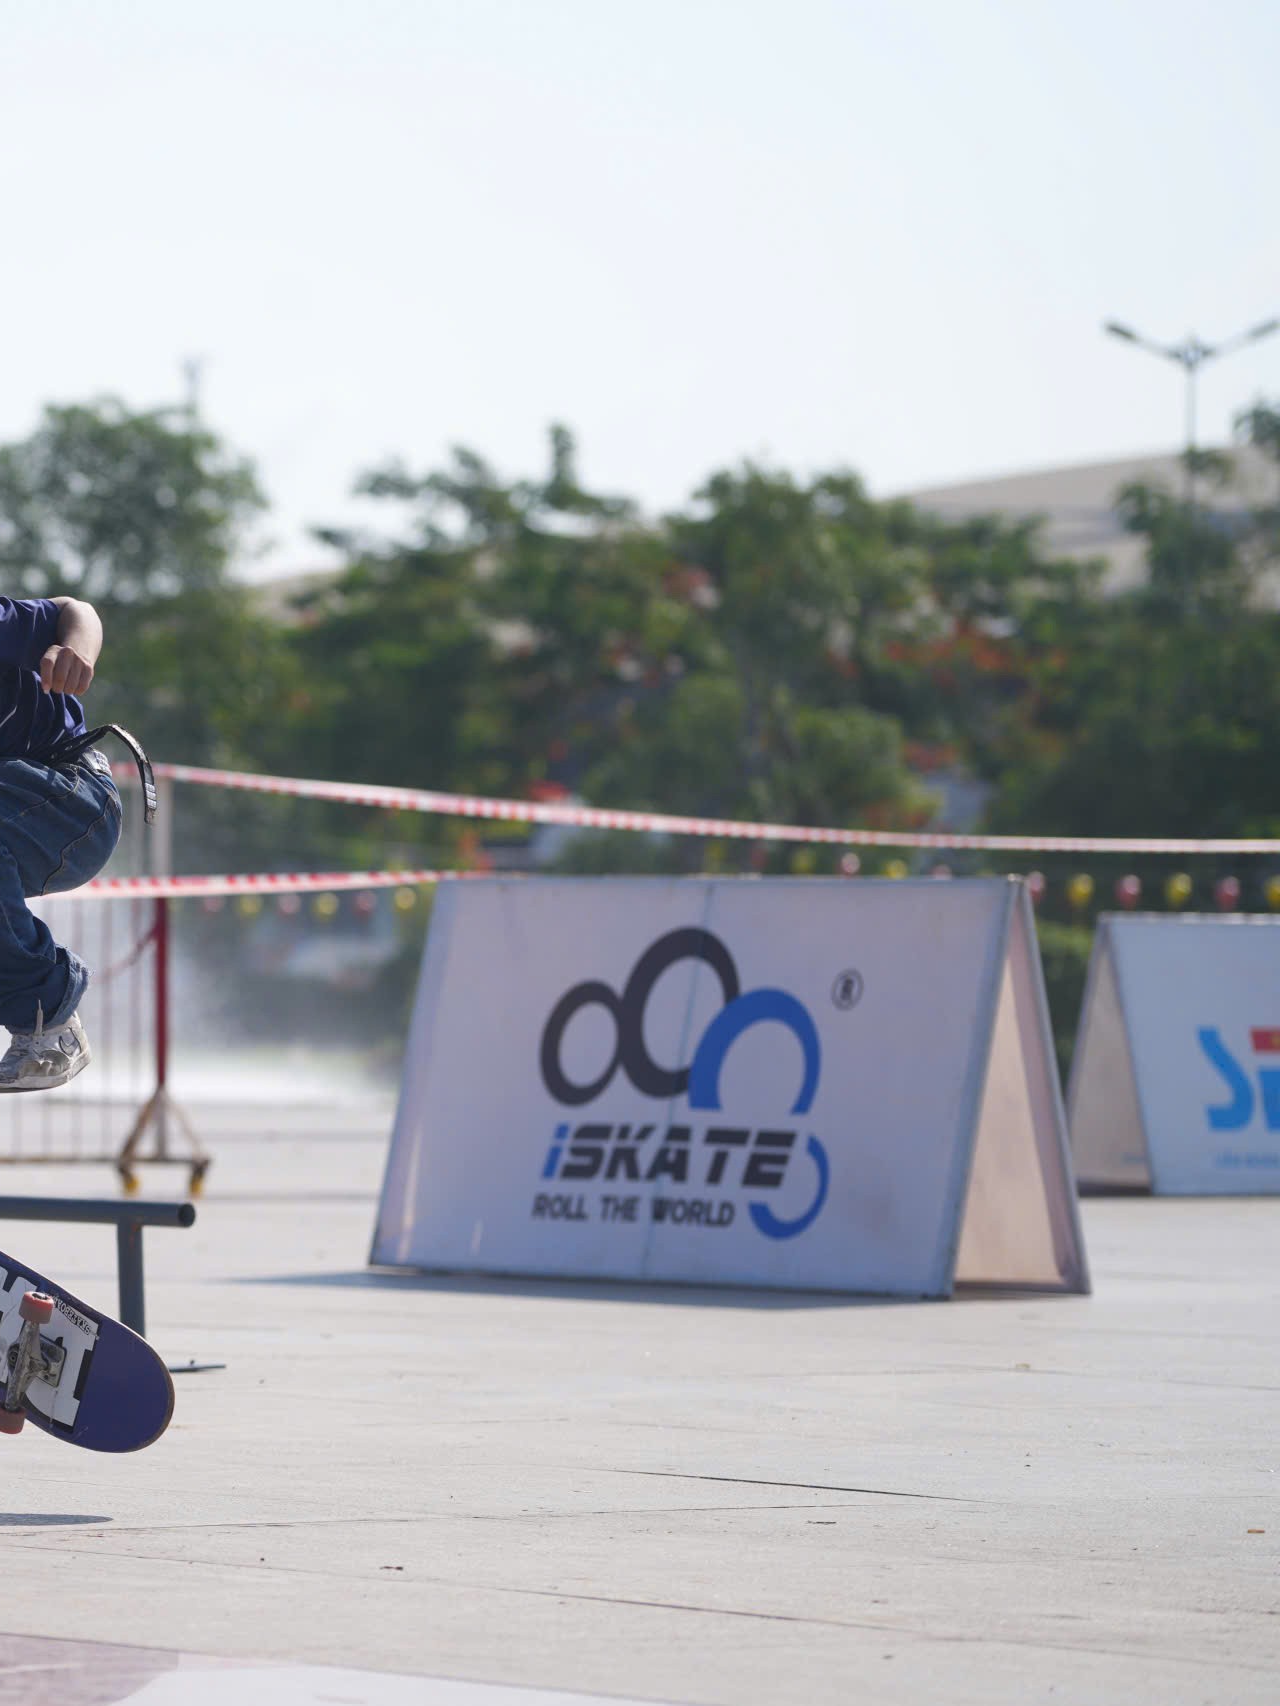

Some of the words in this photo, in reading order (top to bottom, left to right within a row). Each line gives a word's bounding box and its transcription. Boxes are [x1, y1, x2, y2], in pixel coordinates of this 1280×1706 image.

[531, 1194, 588, 1222] ROLL
[601, 1196, 640, 1223] THE
[650, 1198, 736, 1228] WORLD
